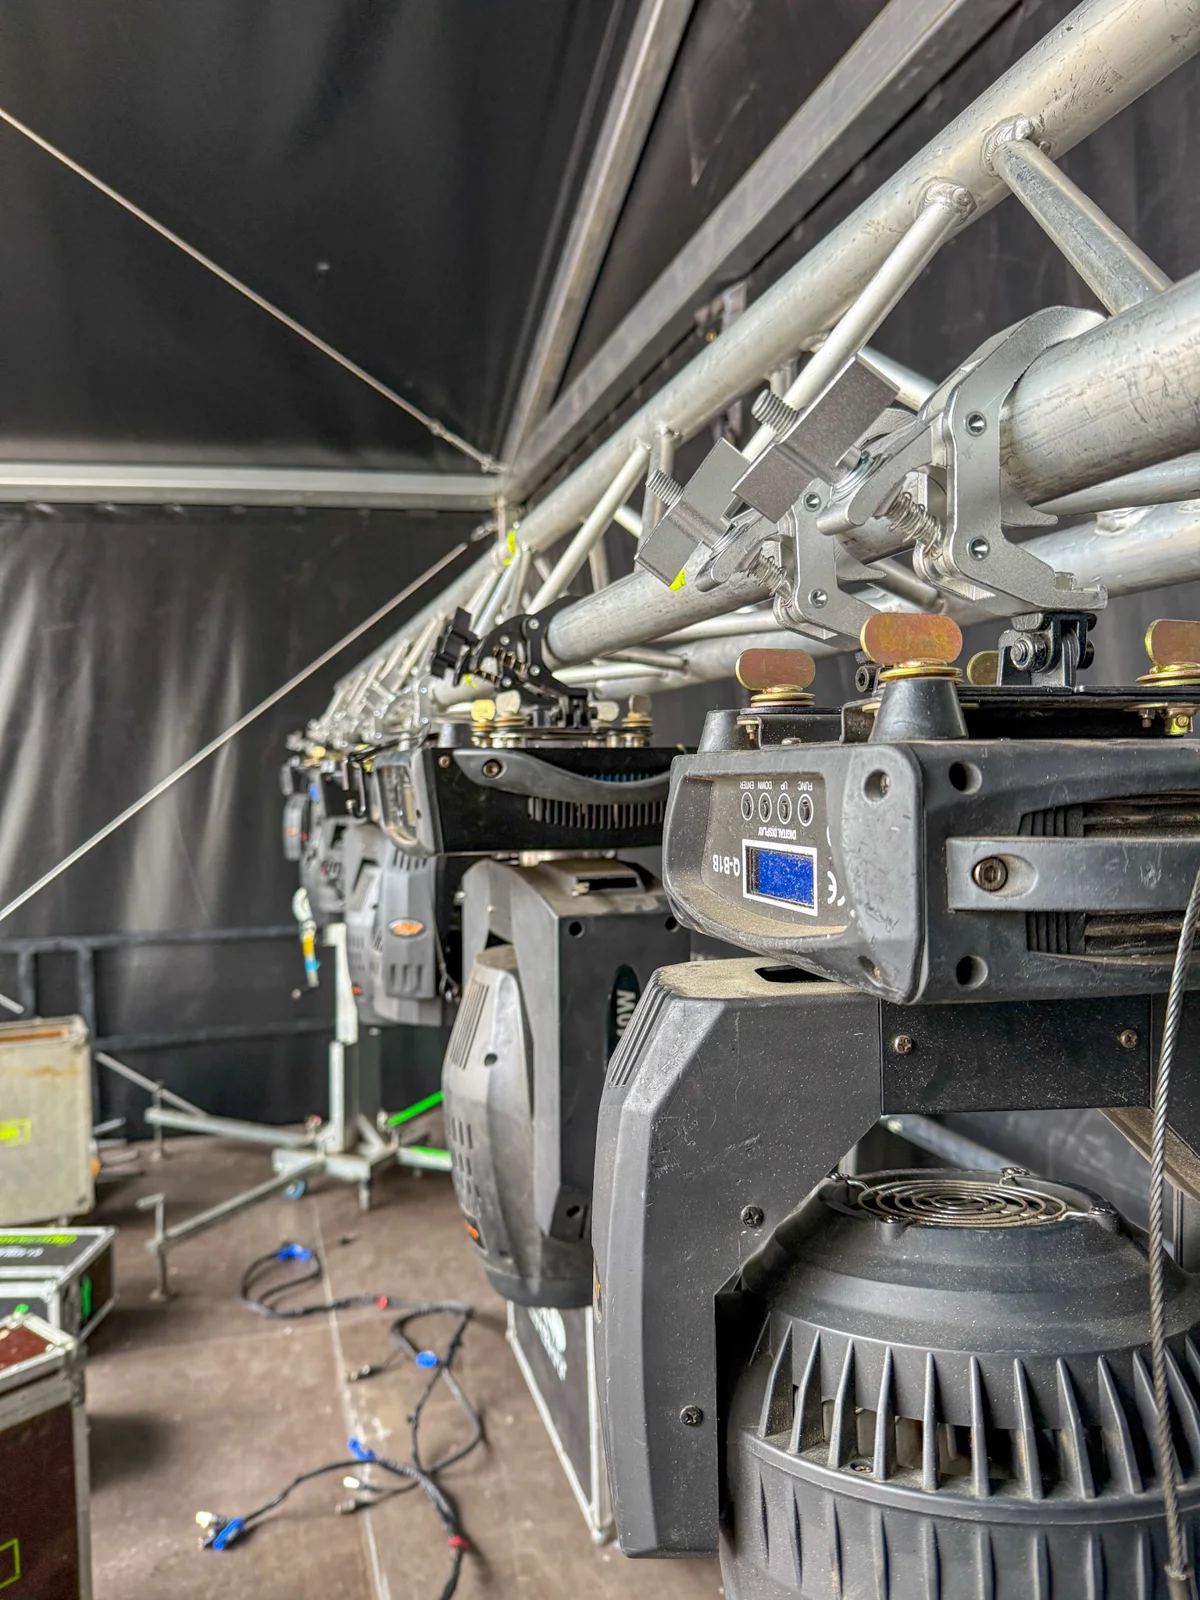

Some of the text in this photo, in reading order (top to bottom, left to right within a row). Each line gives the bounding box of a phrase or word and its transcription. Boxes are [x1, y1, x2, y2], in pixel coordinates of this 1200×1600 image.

[740, 781, 813, 791] FUNC UP DOWN ENTER
[758, 827, 796, 840] DIGITAL DISPLAY
